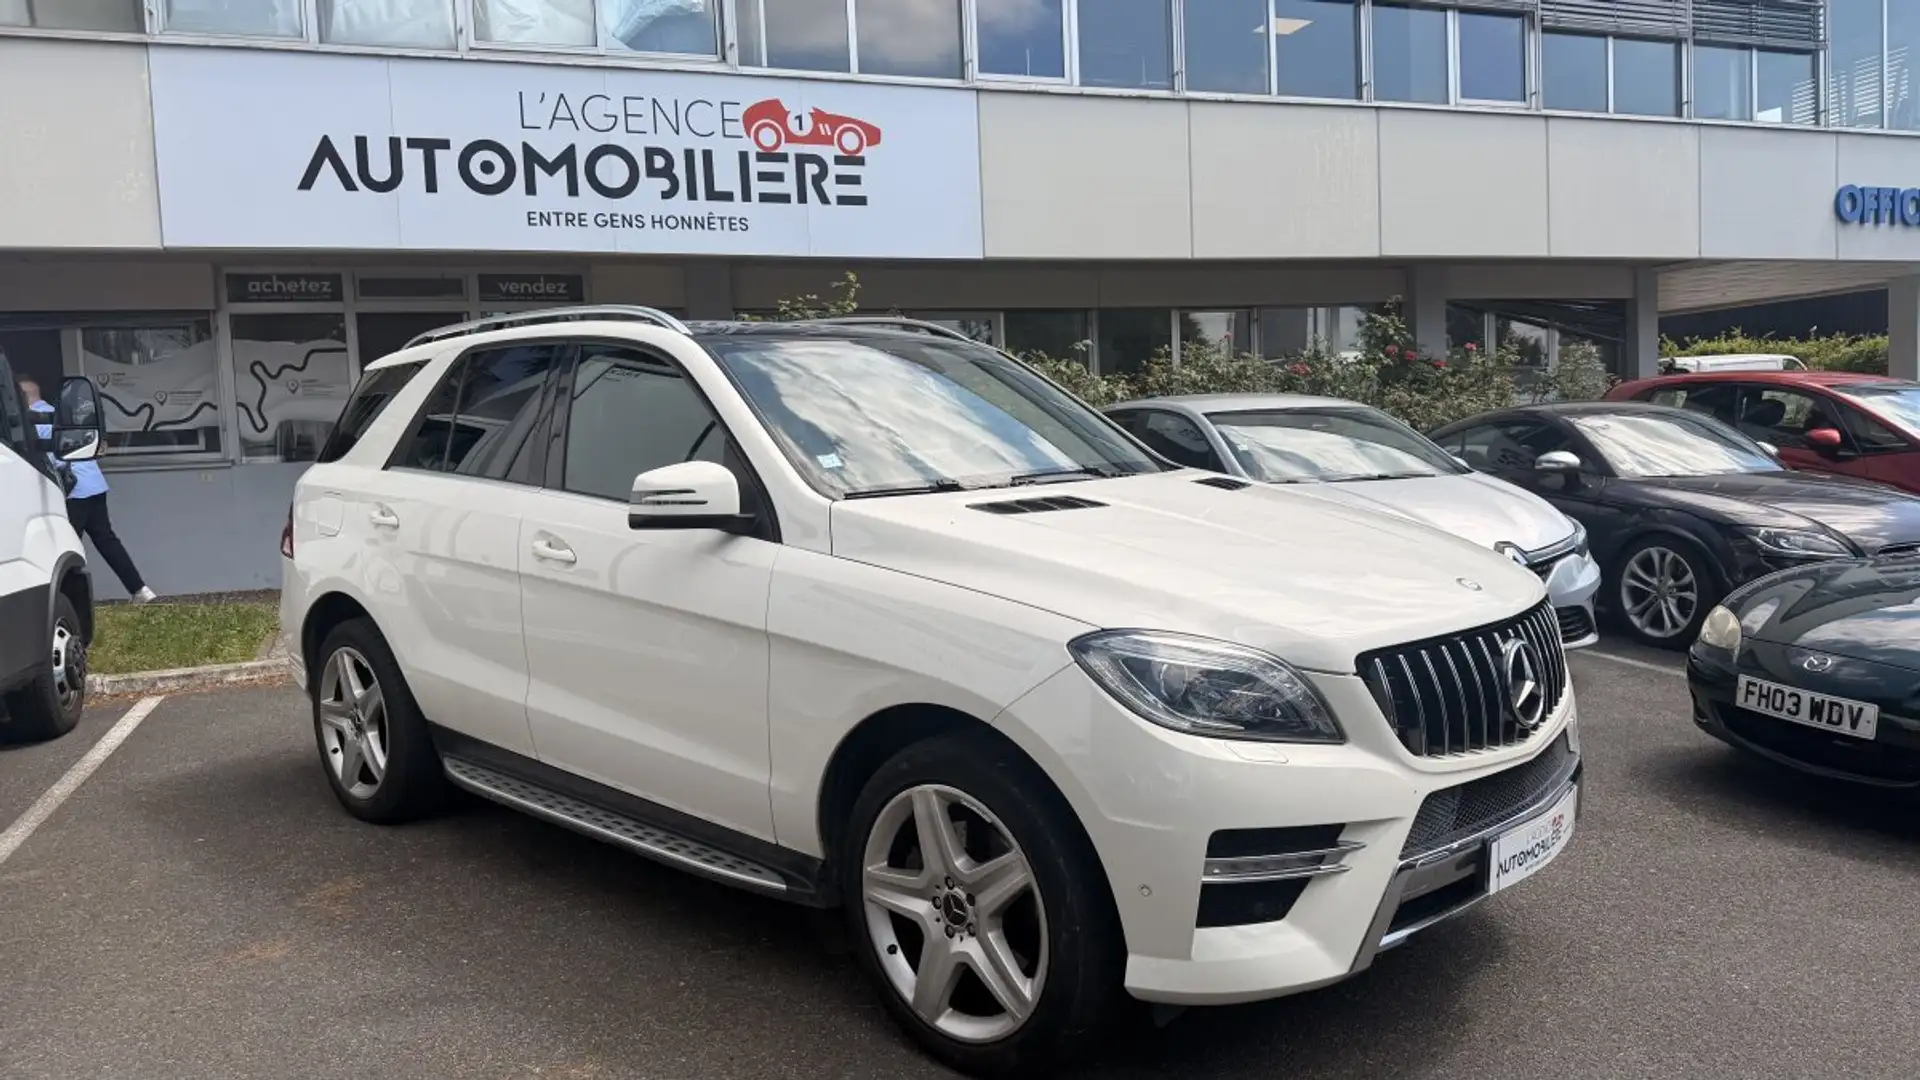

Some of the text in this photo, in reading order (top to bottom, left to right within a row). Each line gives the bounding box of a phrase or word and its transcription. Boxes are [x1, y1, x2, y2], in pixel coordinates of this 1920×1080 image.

[519, 91, 744, 139] L'AGENCE
[794, 113, 803, 131] 1
[527, 211, 749, 232] ENTRE GENS HONNÊTES
[248, 275, 332, 293] achetez
[498, 275, 567, 293] vendez
[1743, 680, 1863, 730] FH03 WDV
